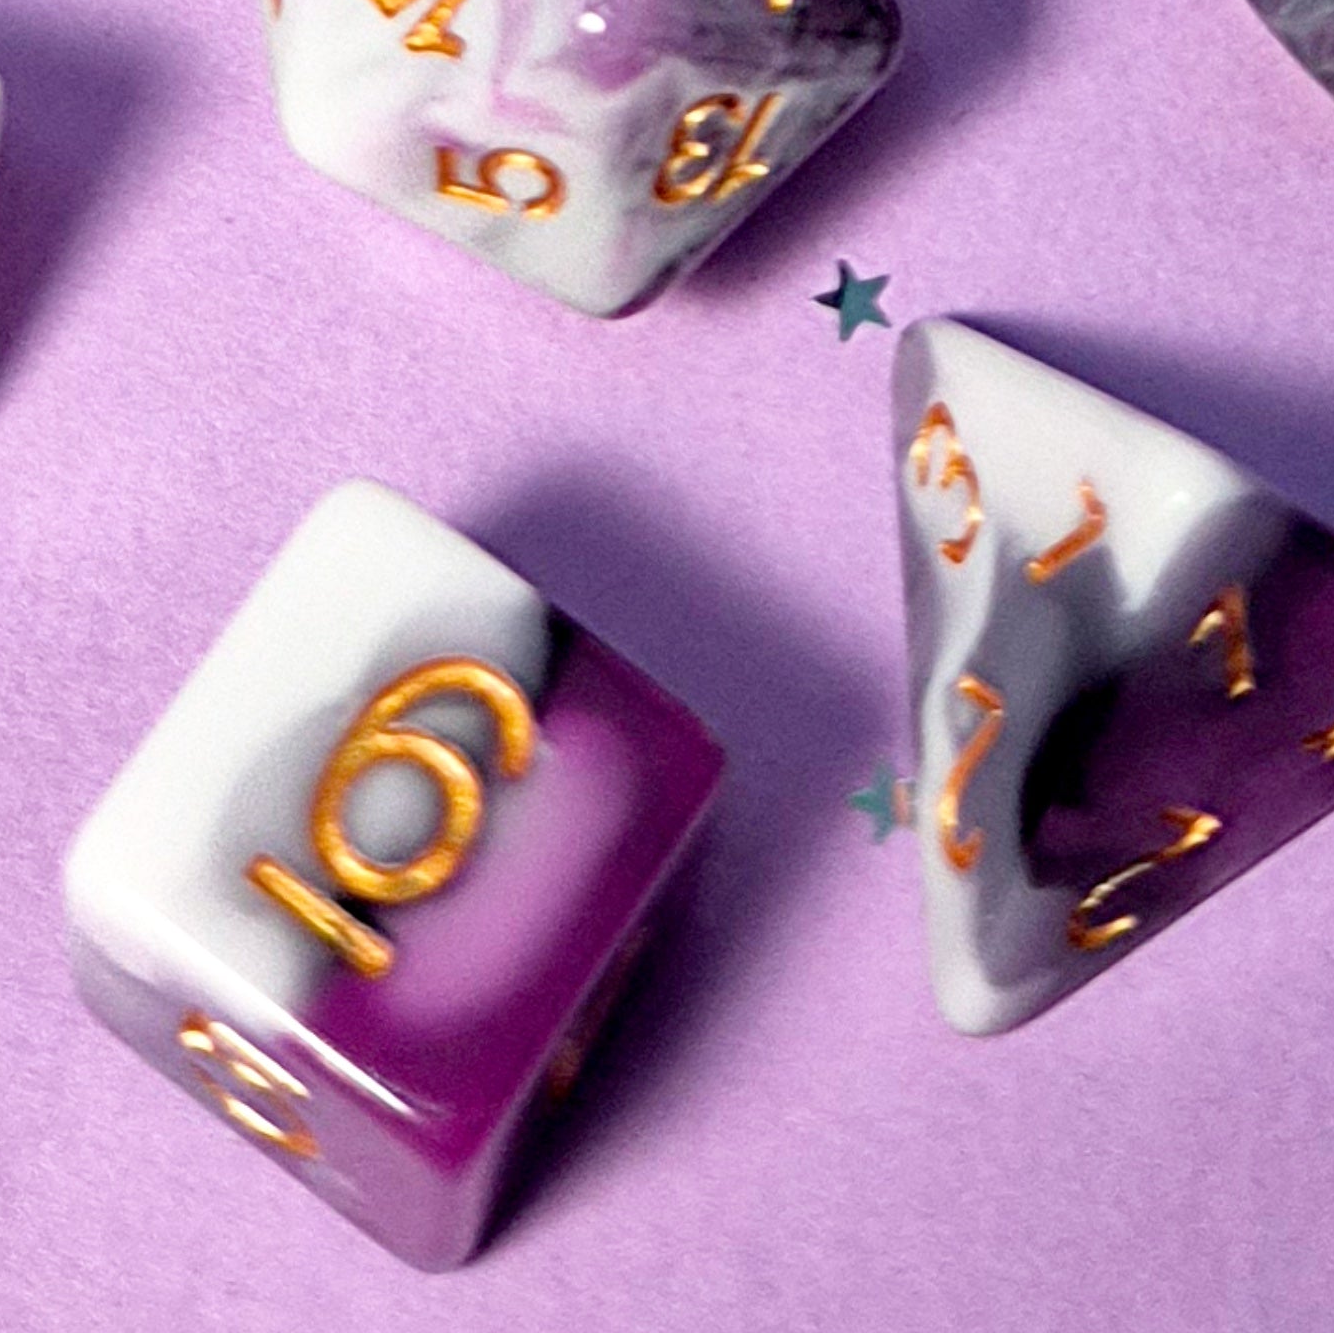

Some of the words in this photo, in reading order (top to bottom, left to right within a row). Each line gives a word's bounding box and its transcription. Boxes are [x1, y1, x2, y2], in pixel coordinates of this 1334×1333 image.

[431, 143, 569, 221] 5
[653, 90, 786, 205] 13
[909, 400, 984, 564] 3
[1189, 586, 1258, 700] 1
